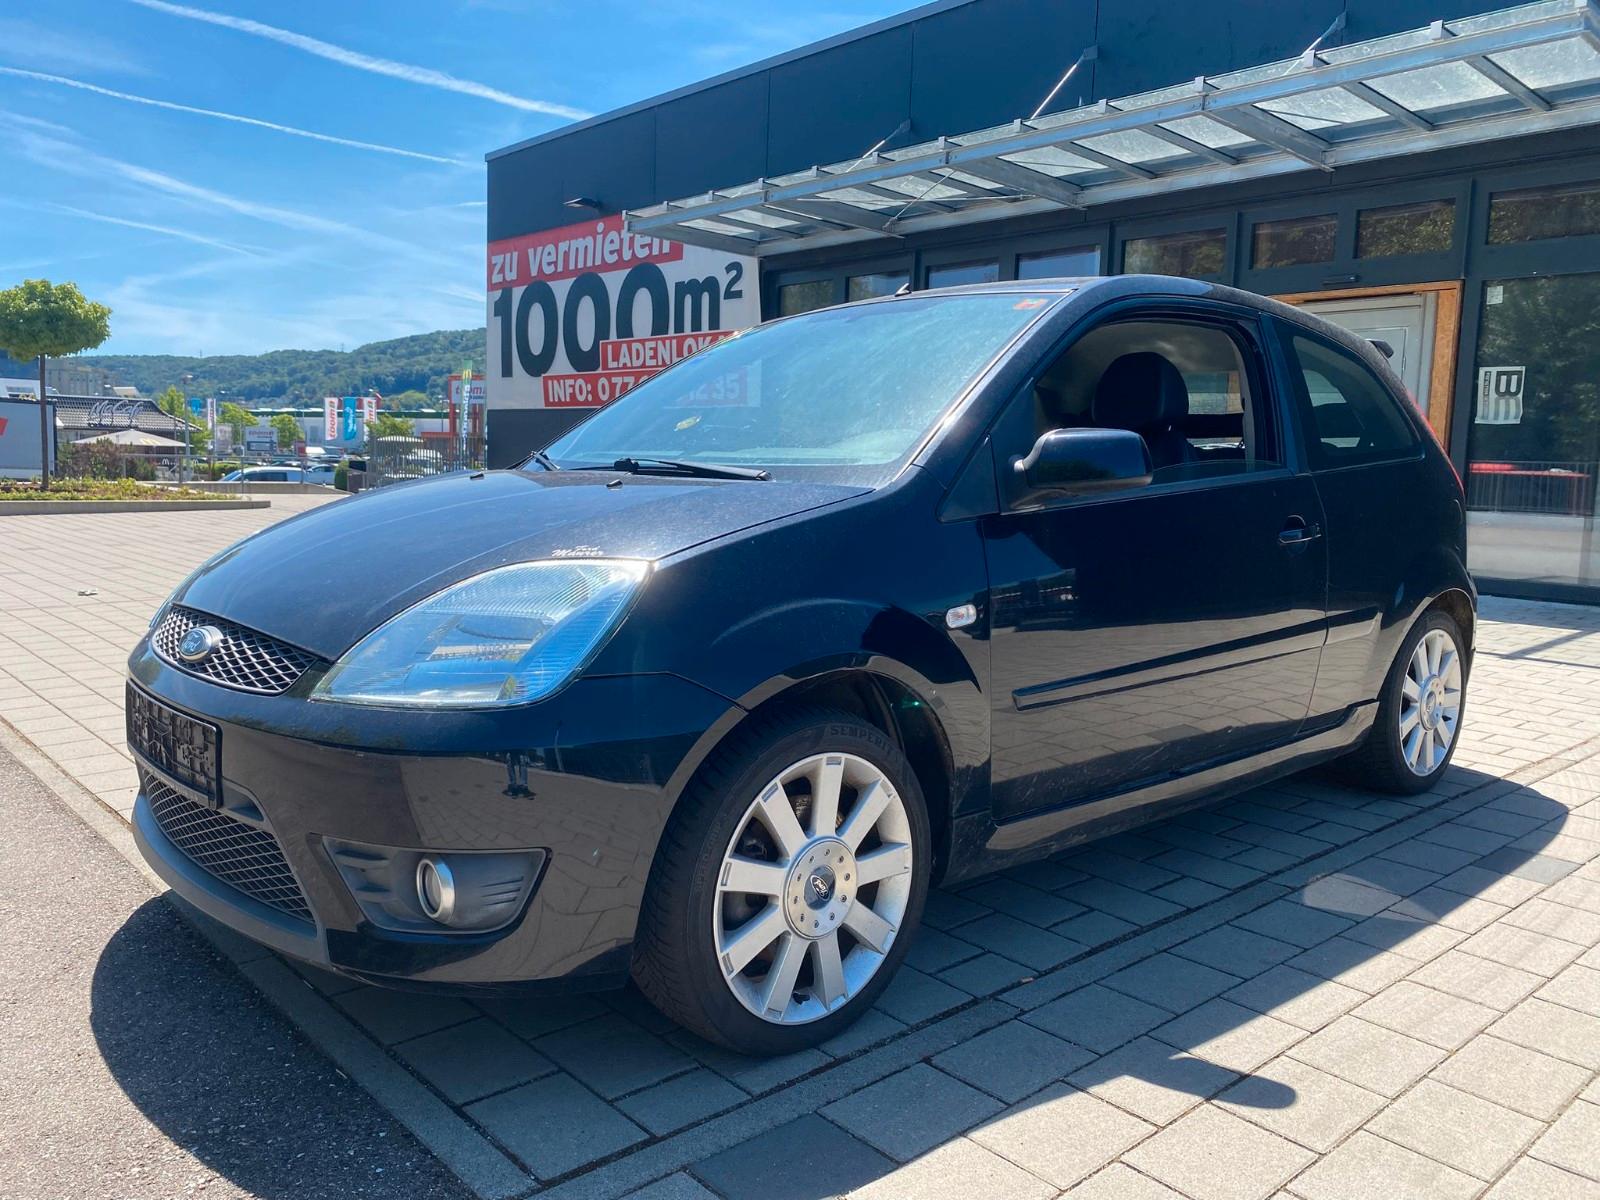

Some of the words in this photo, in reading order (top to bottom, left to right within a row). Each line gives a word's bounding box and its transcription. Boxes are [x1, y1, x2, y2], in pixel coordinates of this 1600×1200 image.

[491, 250, 519, 284] zu
[528, 222, 671, 277] vermieten
[548, 378, 593, 403] INFO:
